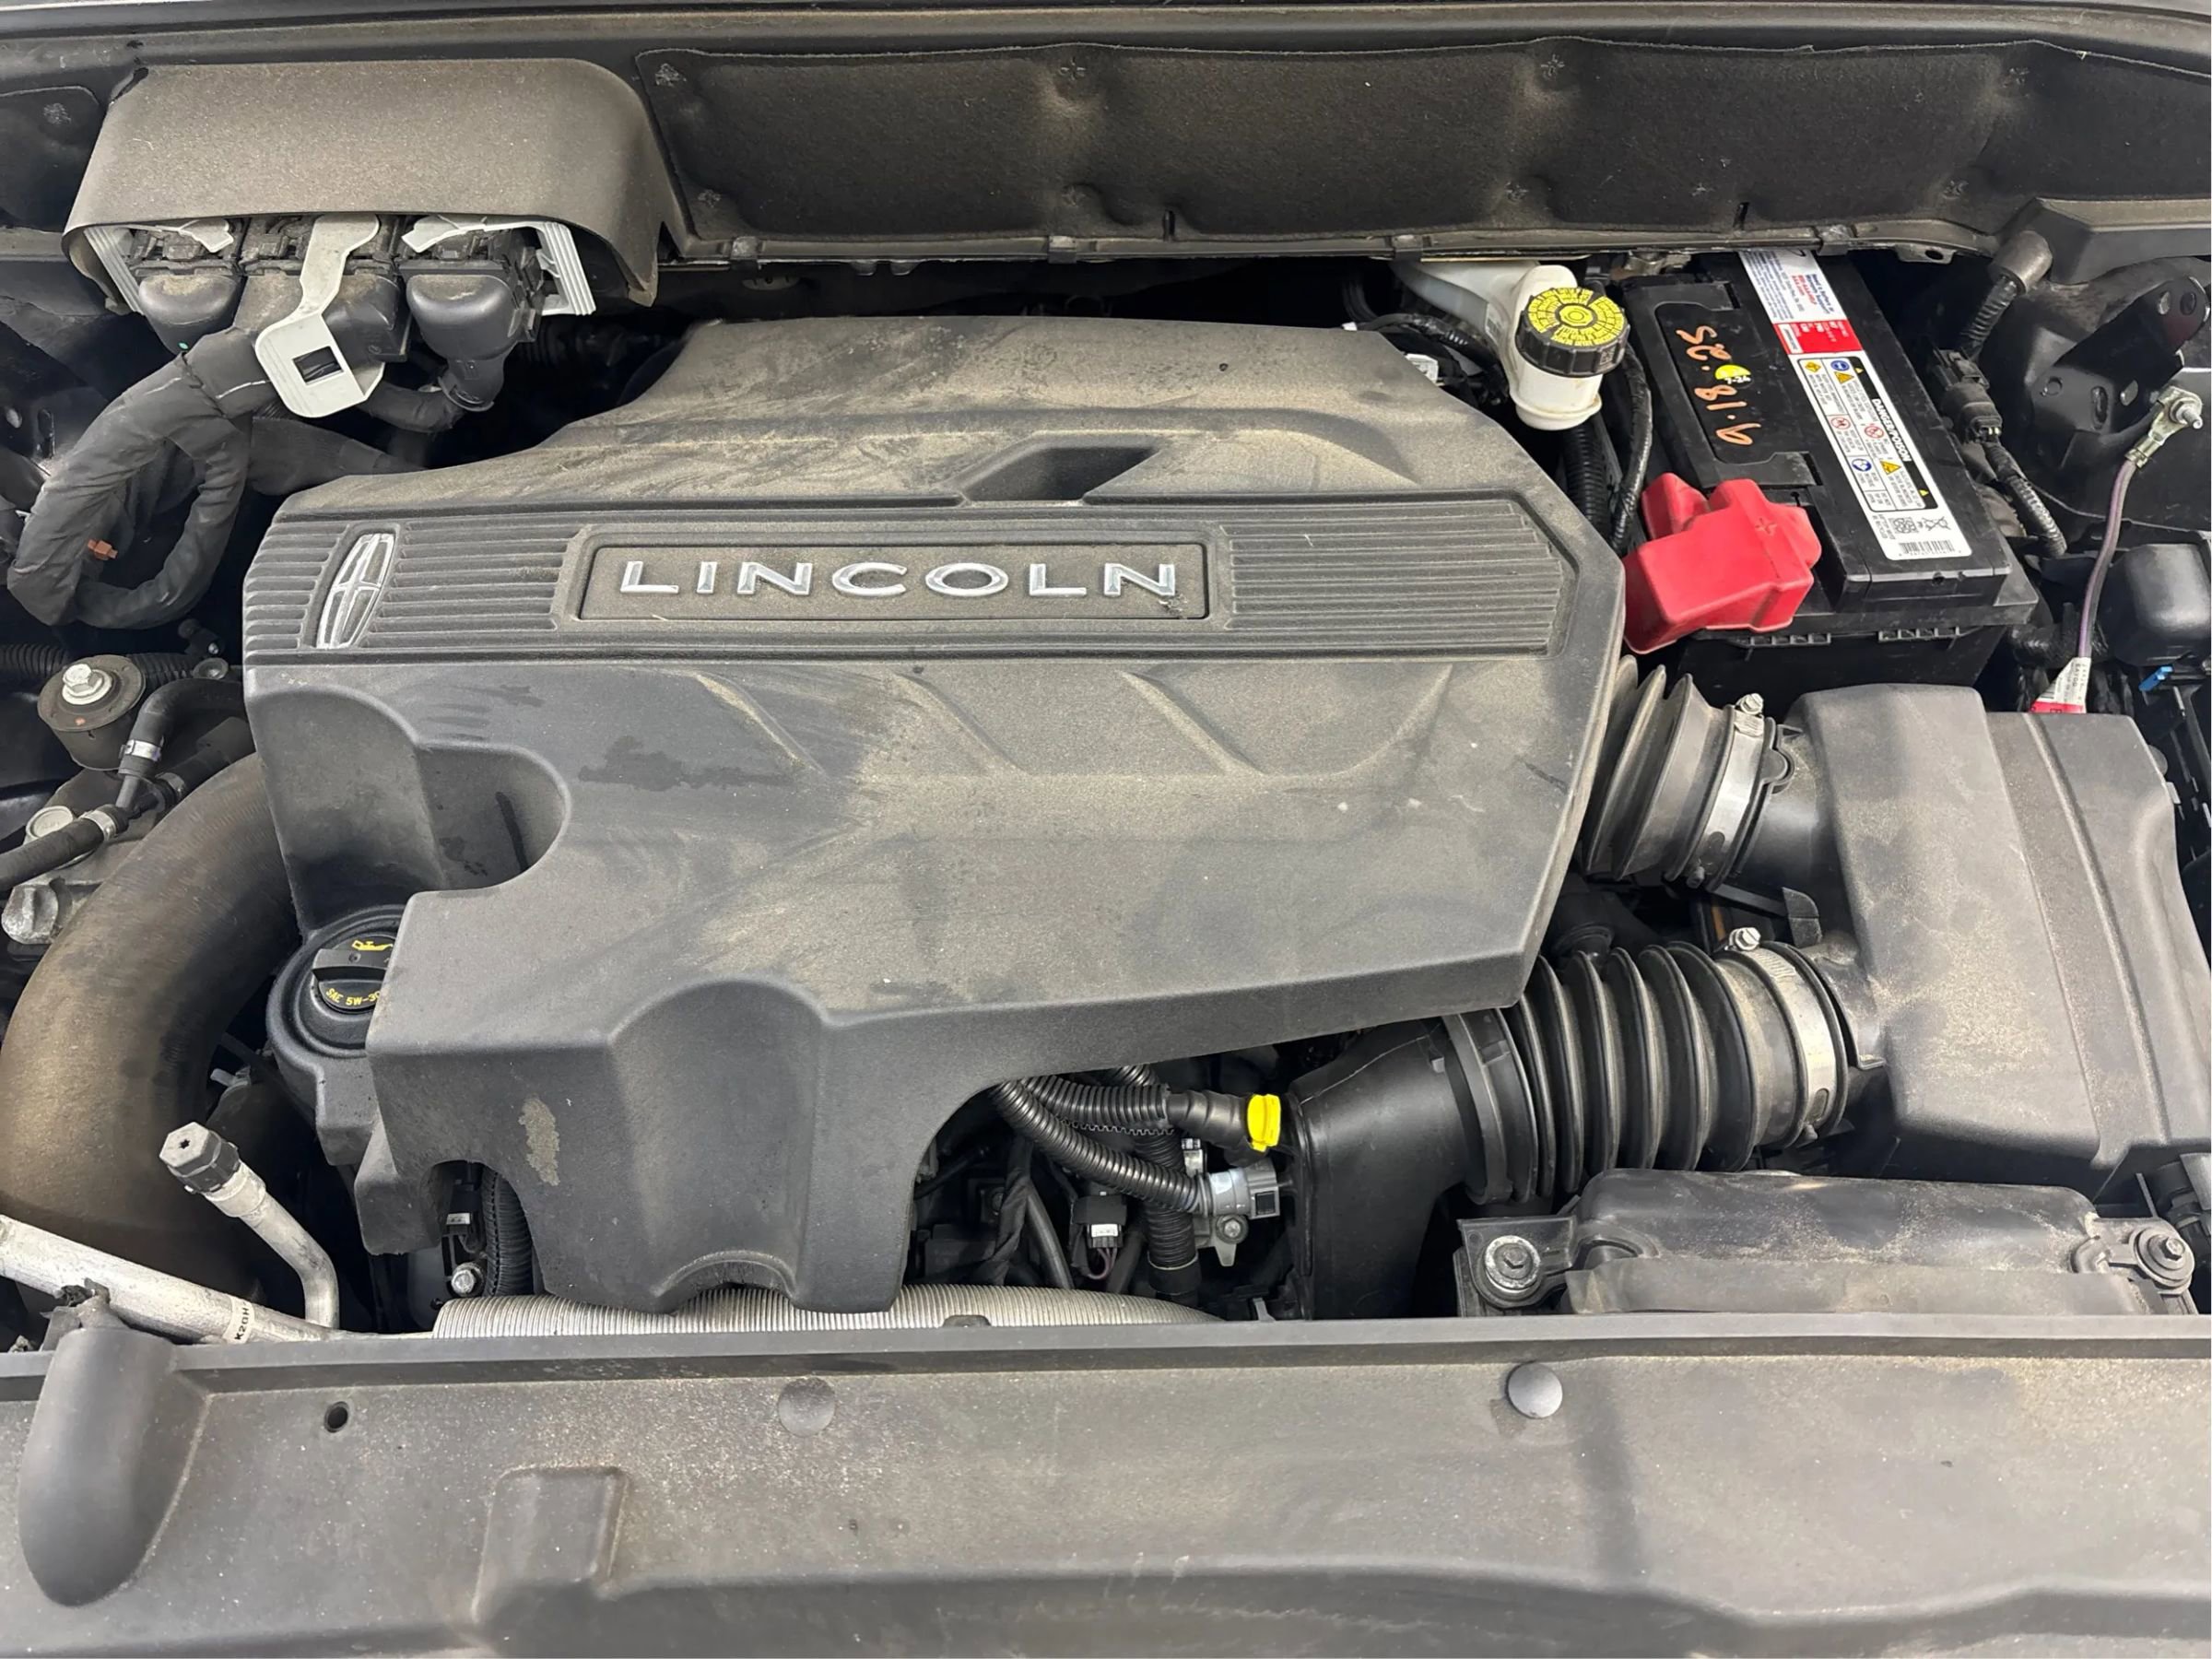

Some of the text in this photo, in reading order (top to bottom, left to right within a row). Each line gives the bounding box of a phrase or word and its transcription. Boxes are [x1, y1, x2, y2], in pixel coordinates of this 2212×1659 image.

[1676, 325, 1761, 445] 9.18.25
[1872, 398, 1912, 462] DANGER/POISON
[619, 560, 1176, 597] LINCOLN
[325, 988, 344, 1004] SAE
